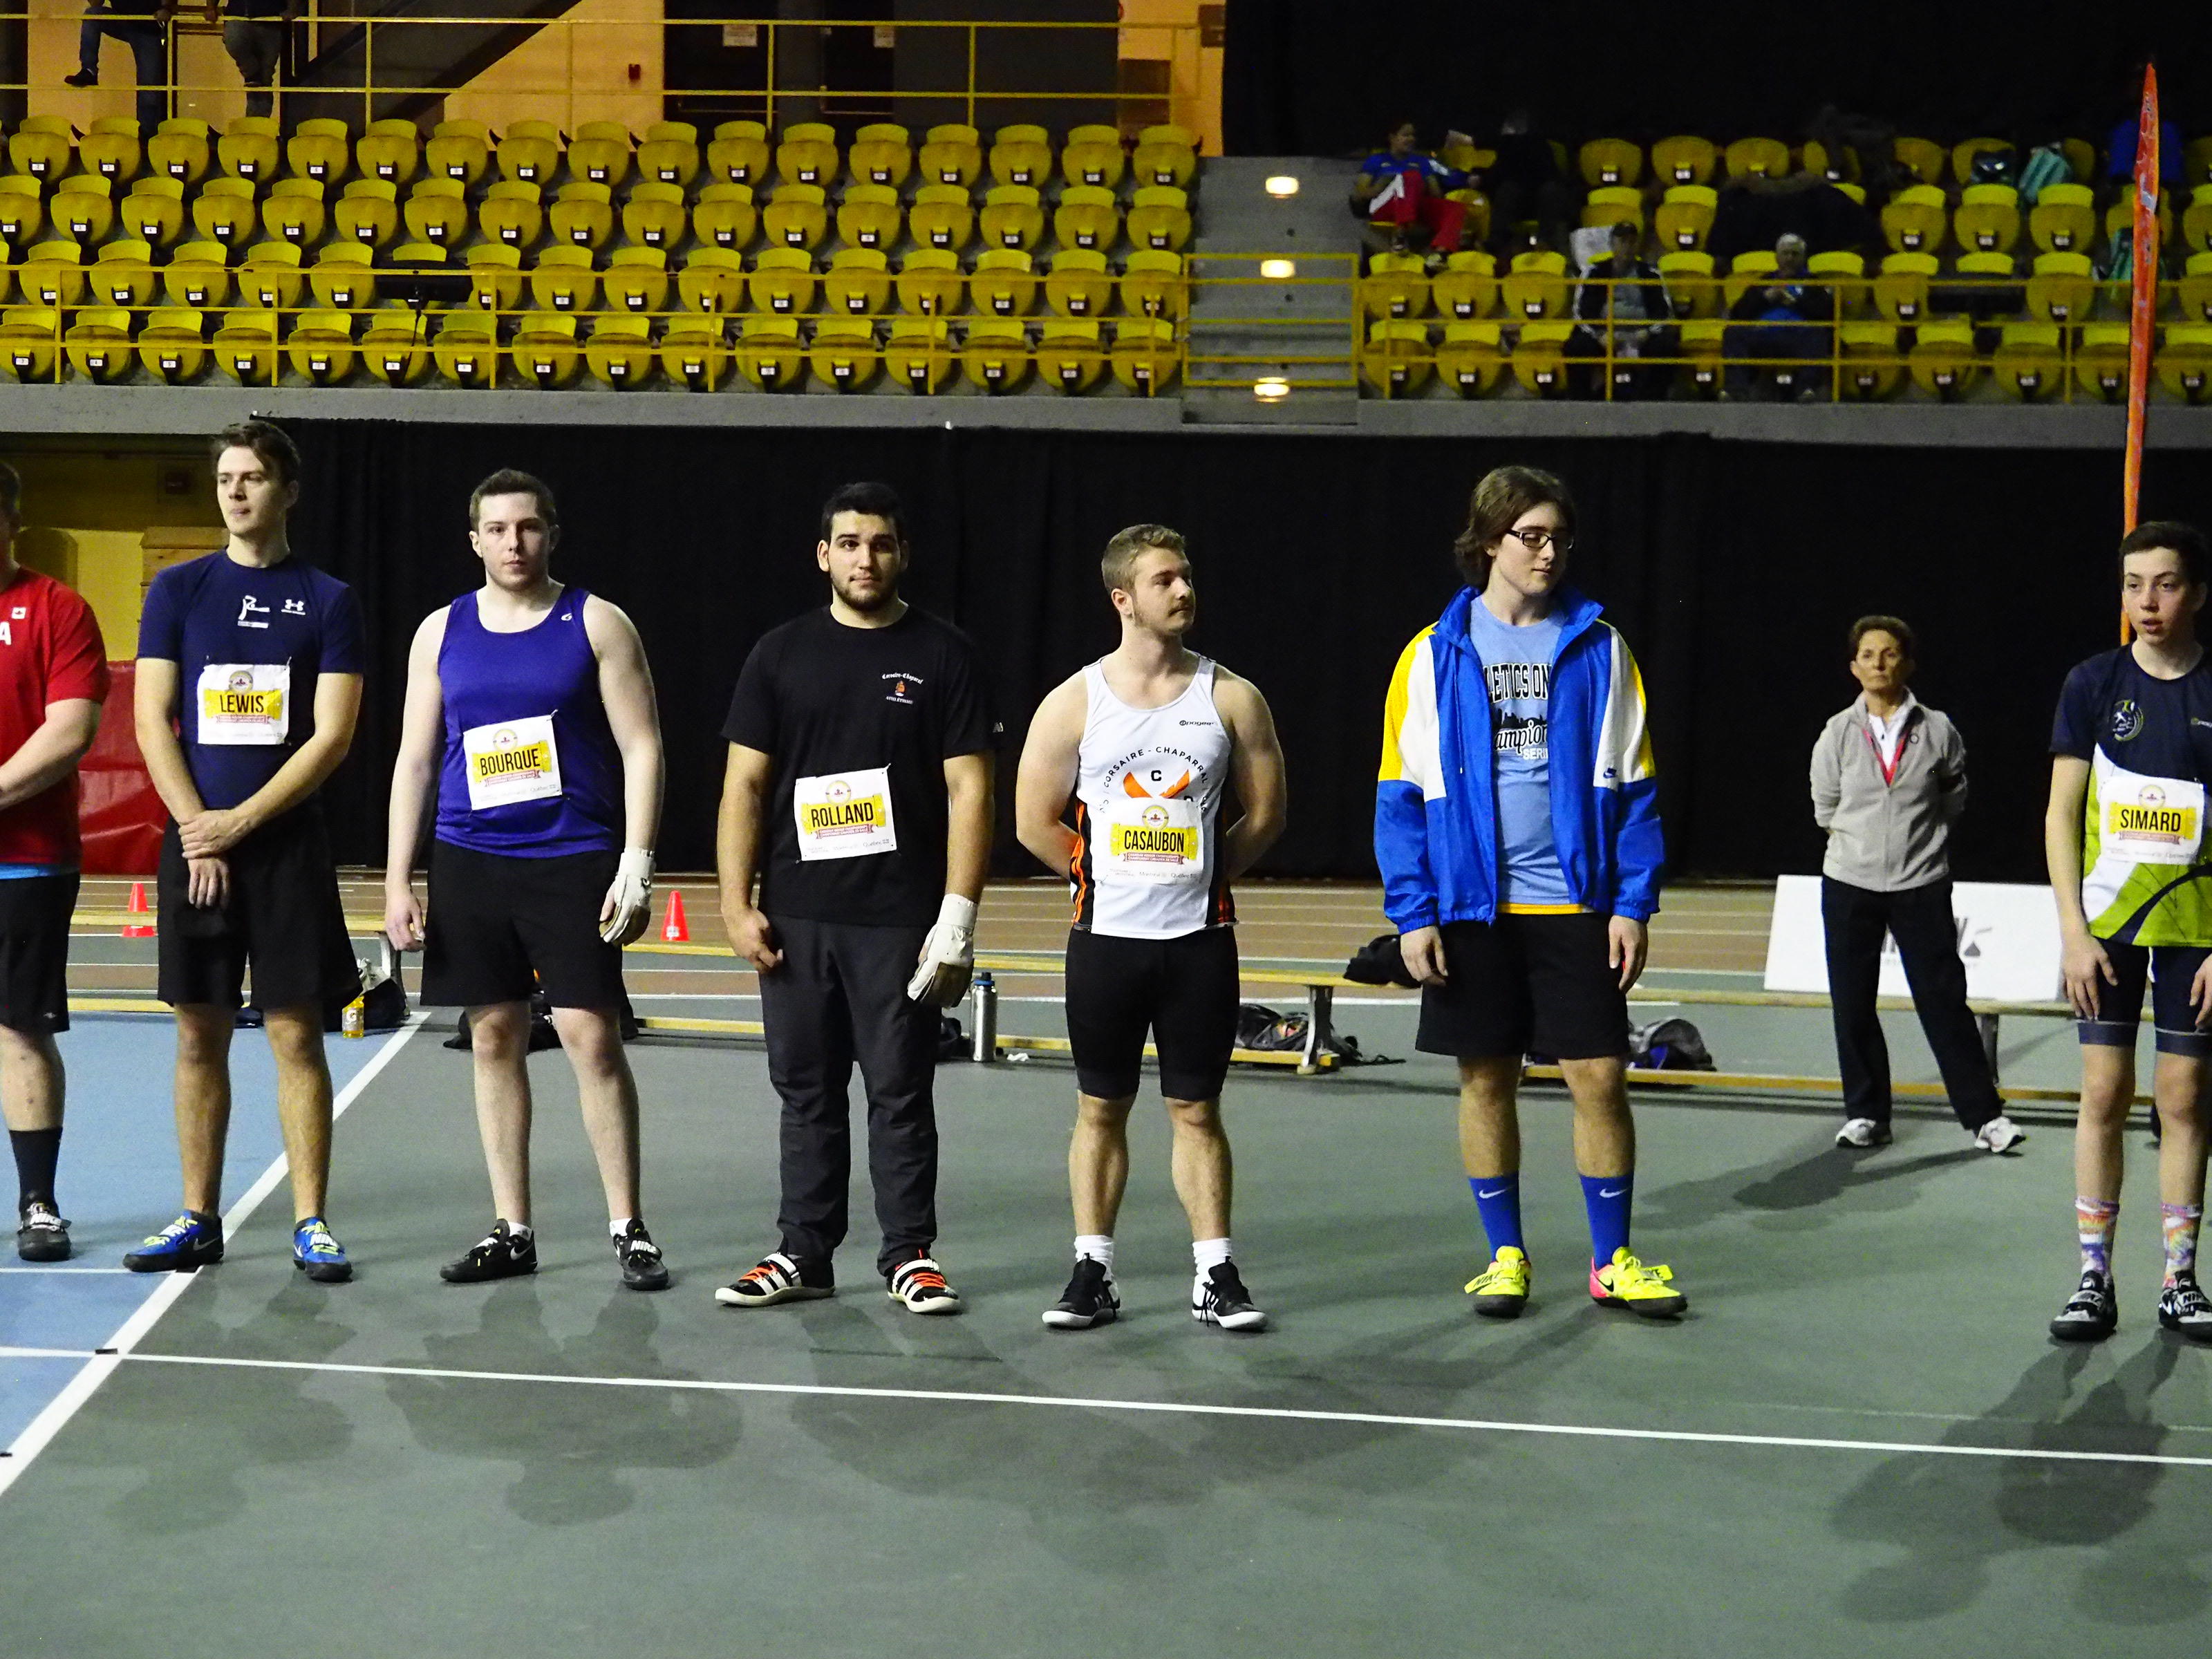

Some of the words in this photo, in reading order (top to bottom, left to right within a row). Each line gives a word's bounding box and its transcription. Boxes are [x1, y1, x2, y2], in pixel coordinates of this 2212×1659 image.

[220, 695, 264, 713] LEWIS
[480, 748, 541, 776] BOURQUE
[1104, 749, 1145, 787] CORSAIRE
[1156, 747, 1208, 784] CHAPARRAL
[1150, 769, 1162, 782] C
[811, 802, 874, 828] ROLLAND
[2120, 809, 2182, 832] SIMARD
[1124, 830, 1184, 852] CASAUBON
